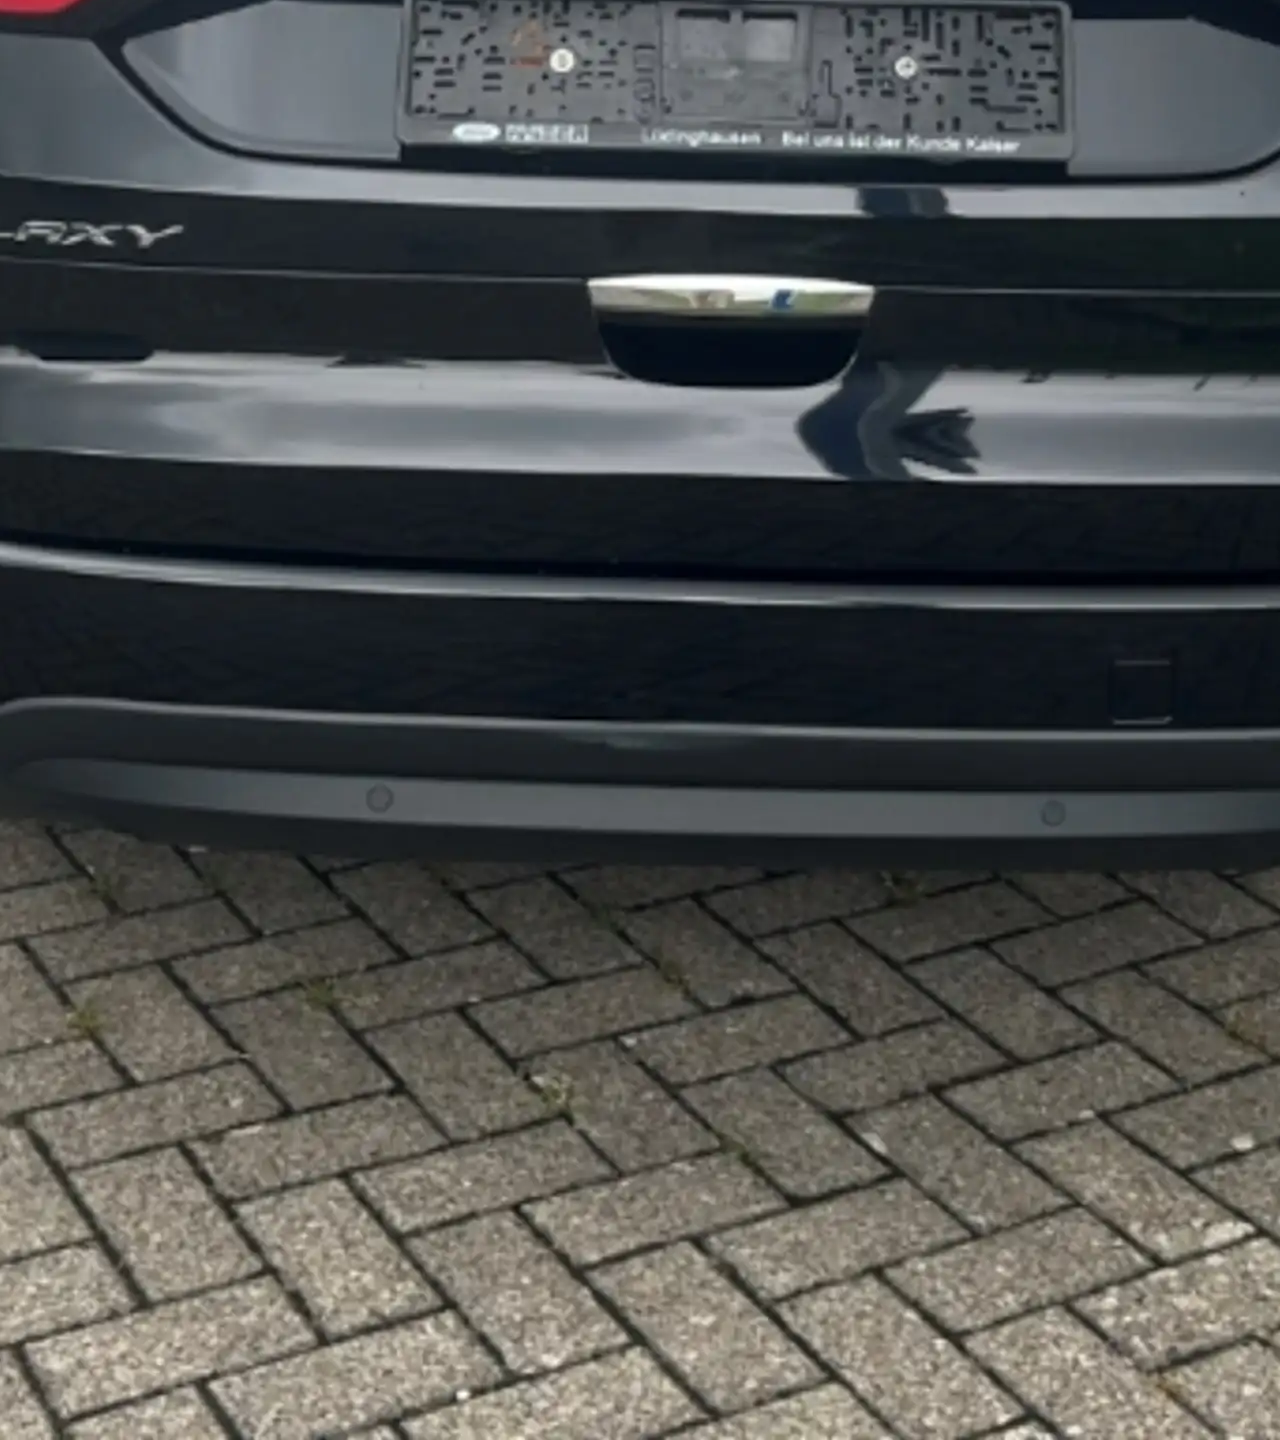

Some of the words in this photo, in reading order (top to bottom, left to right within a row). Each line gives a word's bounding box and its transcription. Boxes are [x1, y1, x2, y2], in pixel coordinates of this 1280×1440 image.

[873, 133, 903, 150] der
[906, 134, 961, 151] Kunde
[966, 134, 1020, 154] Kaiser
